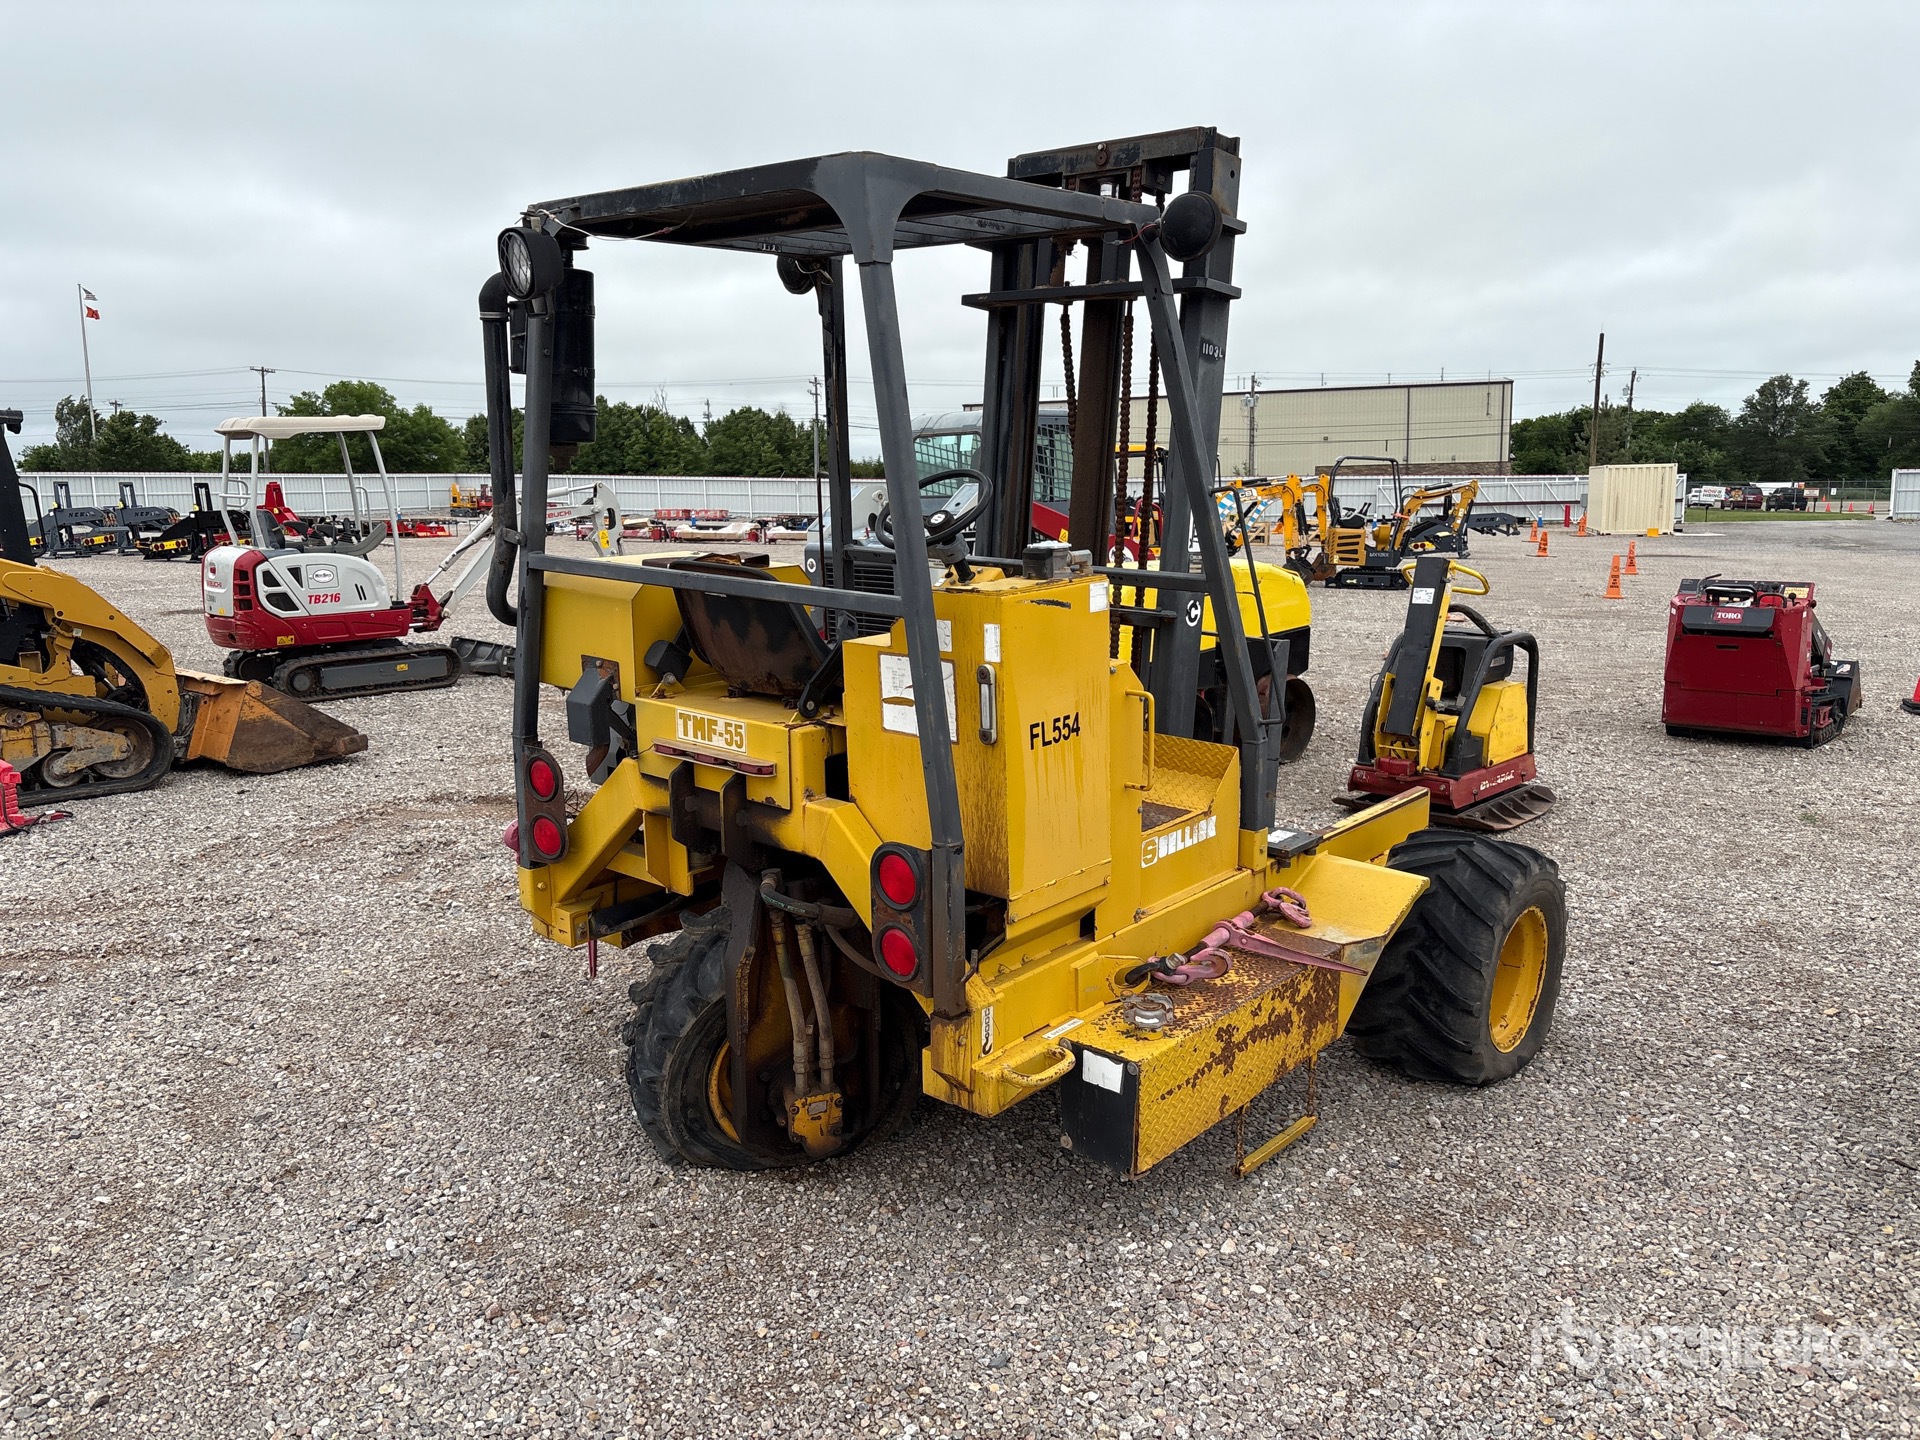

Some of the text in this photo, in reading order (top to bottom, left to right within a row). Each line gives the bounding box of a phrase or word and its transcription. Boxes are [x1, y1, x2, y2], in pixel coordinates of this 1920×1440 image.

[308, 592, 341, 605] TB216
[678, 712, 744, 749] TMF-55
[1029, 711, 1081, 751] FL554
